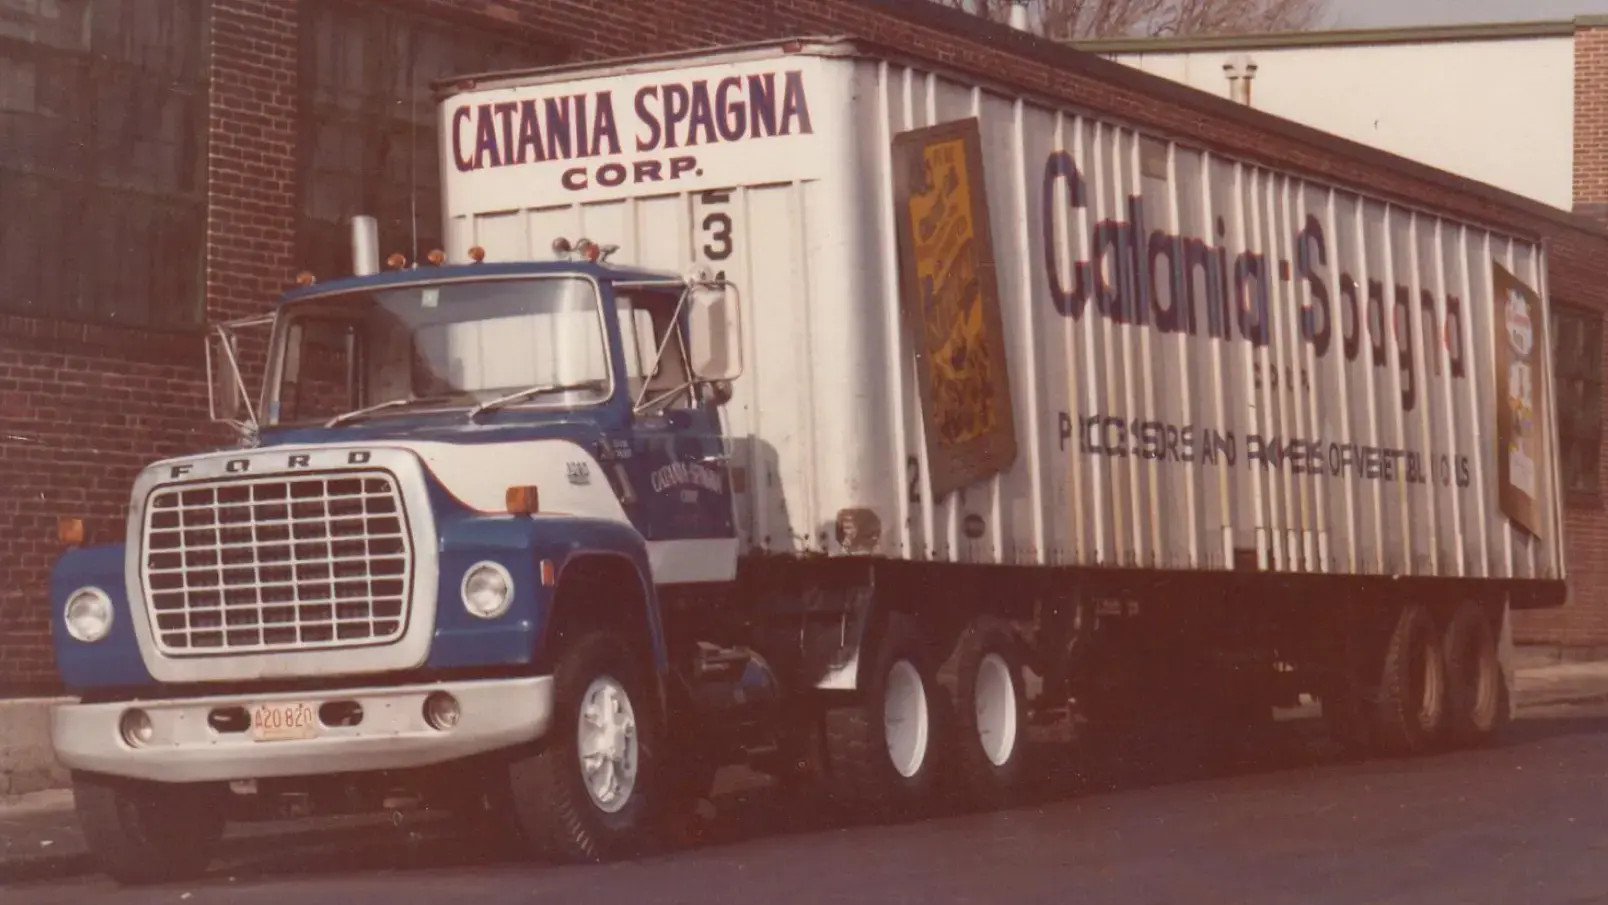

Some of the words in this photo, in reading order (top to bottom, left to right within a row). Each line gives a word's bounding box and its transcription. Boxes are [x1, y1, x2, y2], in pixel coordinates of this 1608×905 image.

[452, 90, 622, 173] CATANIA
[634, 70, 814, 153] SPAGNA
[561, 155, 704, 191] CORP.
[170, 451, 371, 478] FORD
